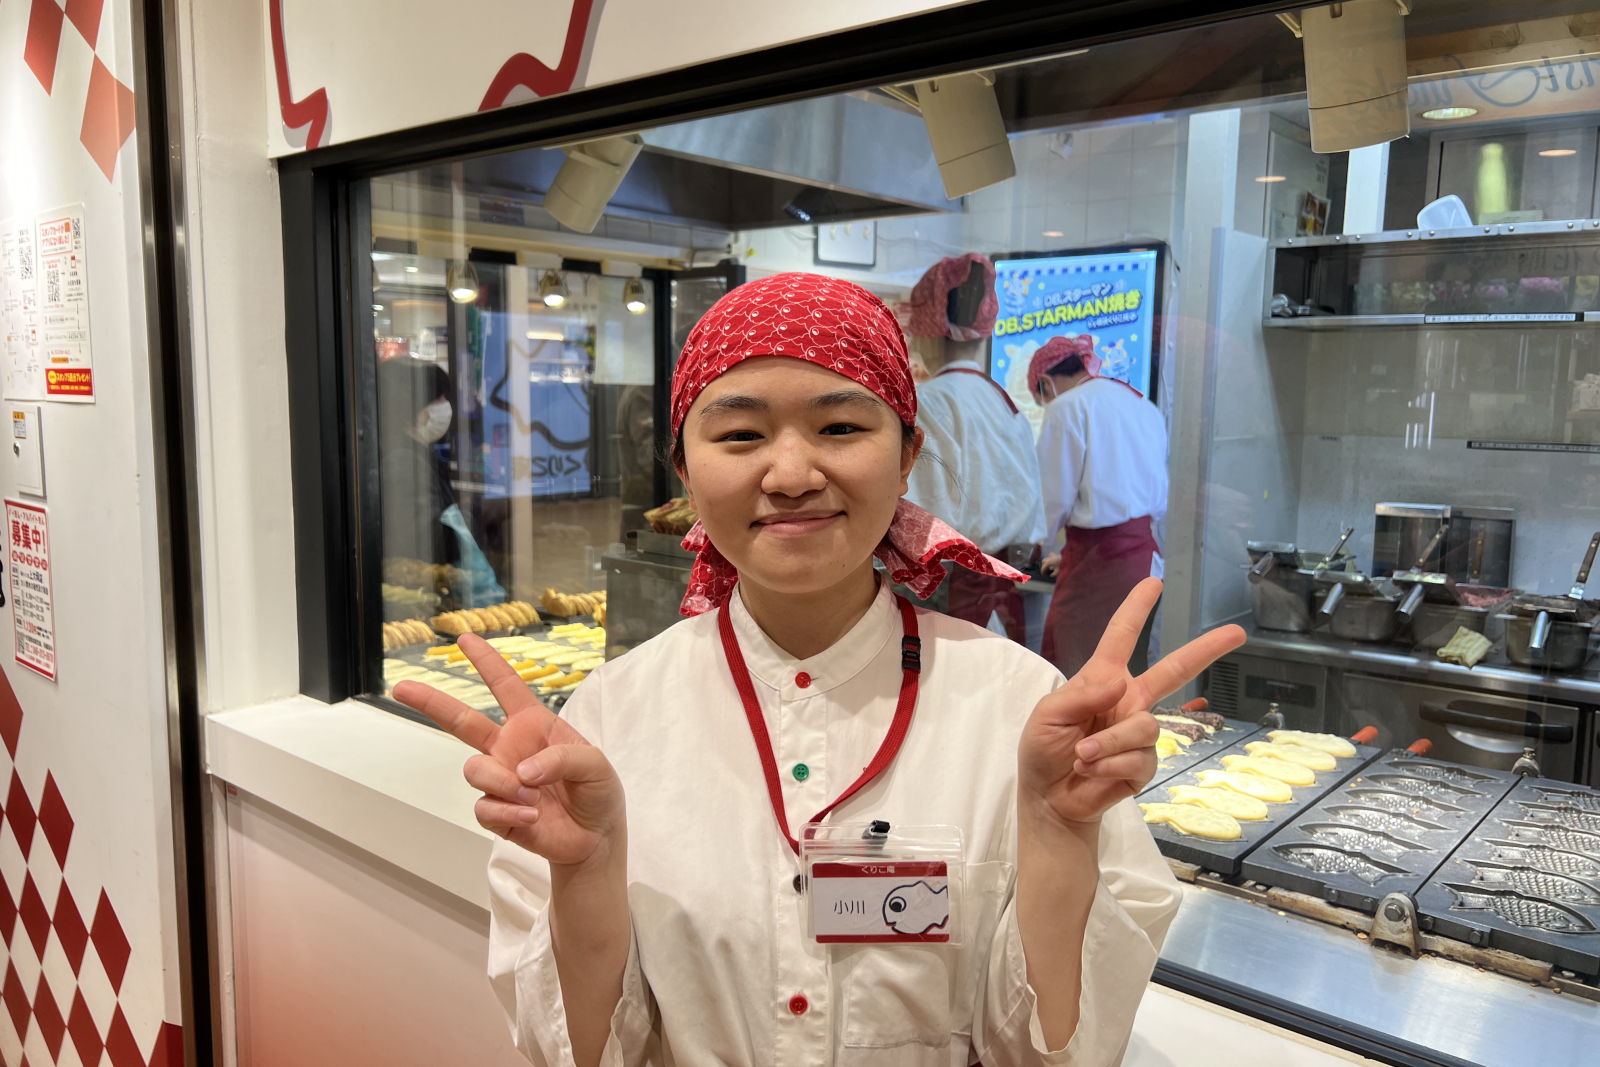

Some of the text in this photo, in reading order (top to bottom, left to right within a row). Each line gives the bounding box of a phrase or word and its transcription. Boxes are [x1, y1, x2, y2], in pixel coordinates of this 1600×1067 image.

[12, 519, 46, 555] 募集中!
[861, 865, 896, 875] くりこ庵
[833, 900, 866, 915] 小川
